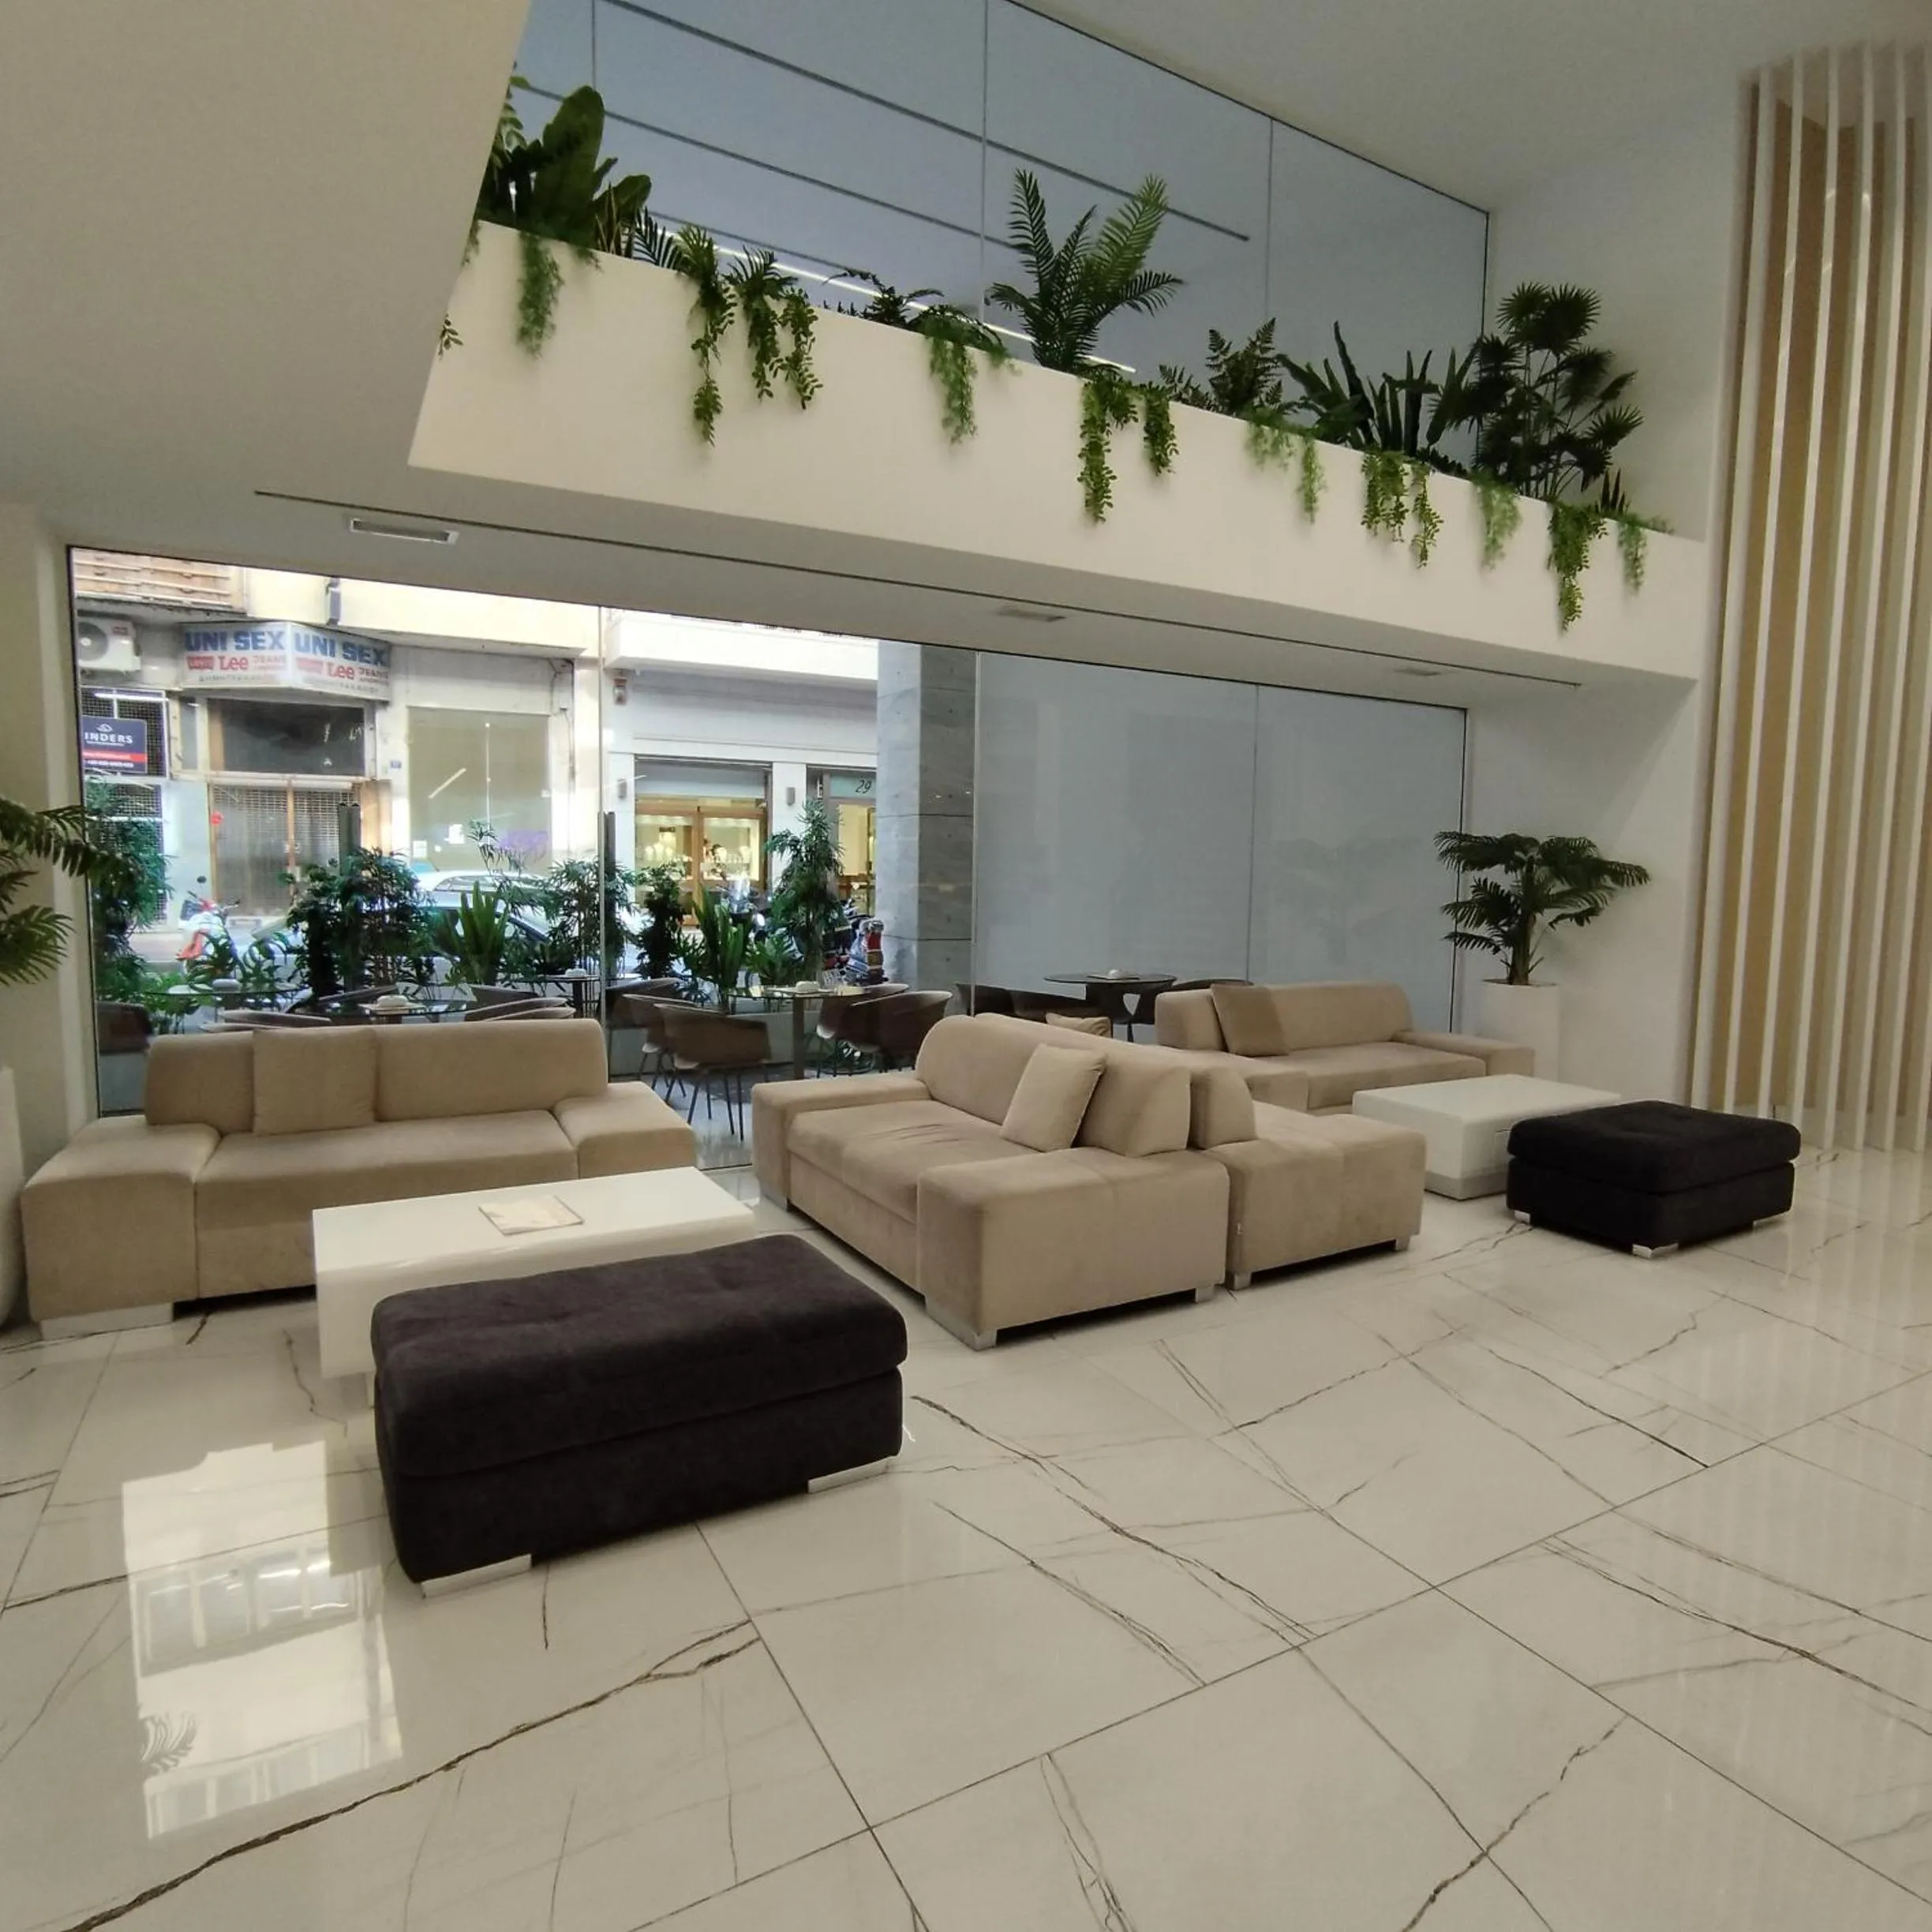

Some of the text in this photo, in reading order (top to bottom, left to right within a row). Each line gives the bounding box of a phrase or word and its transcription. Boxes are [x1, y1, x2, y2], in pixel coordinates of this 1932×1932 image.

[185, 631, 285, 651] UNI SEX
[294, 632, 335, 657] UNI
[342, 641, 390, 667] SEX
[218, 656, 249, 670] Lee
[327, 661, 354, 680] Lee
[855, 779, 872, 794] 29
